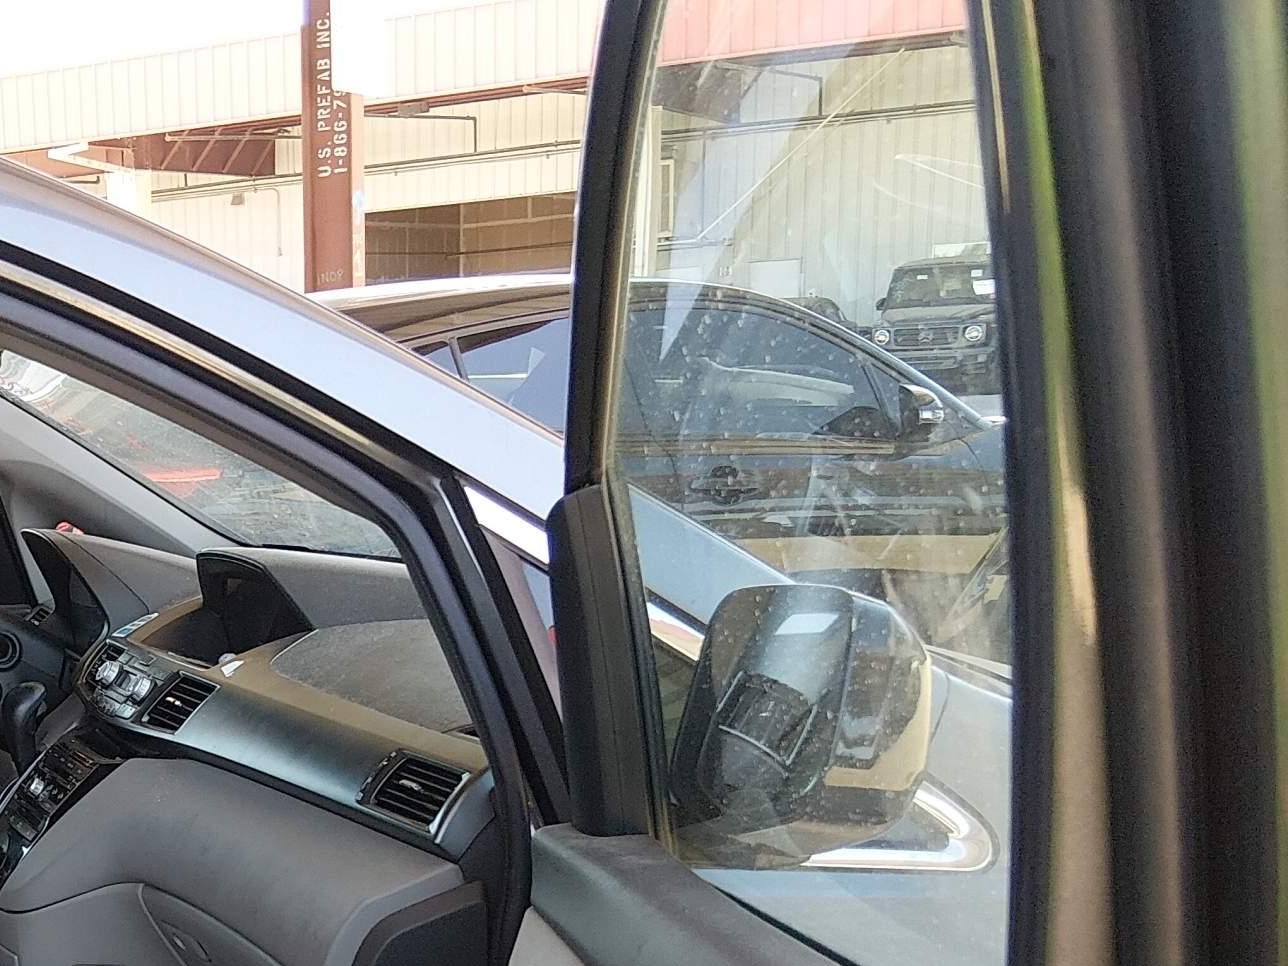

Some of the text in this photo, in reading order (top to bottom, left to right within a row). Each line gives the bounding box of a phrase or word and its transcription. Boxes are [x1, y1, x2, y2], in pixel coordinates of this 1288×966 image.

[316, 11, 332, 178] U.S. PREFAB INC.
